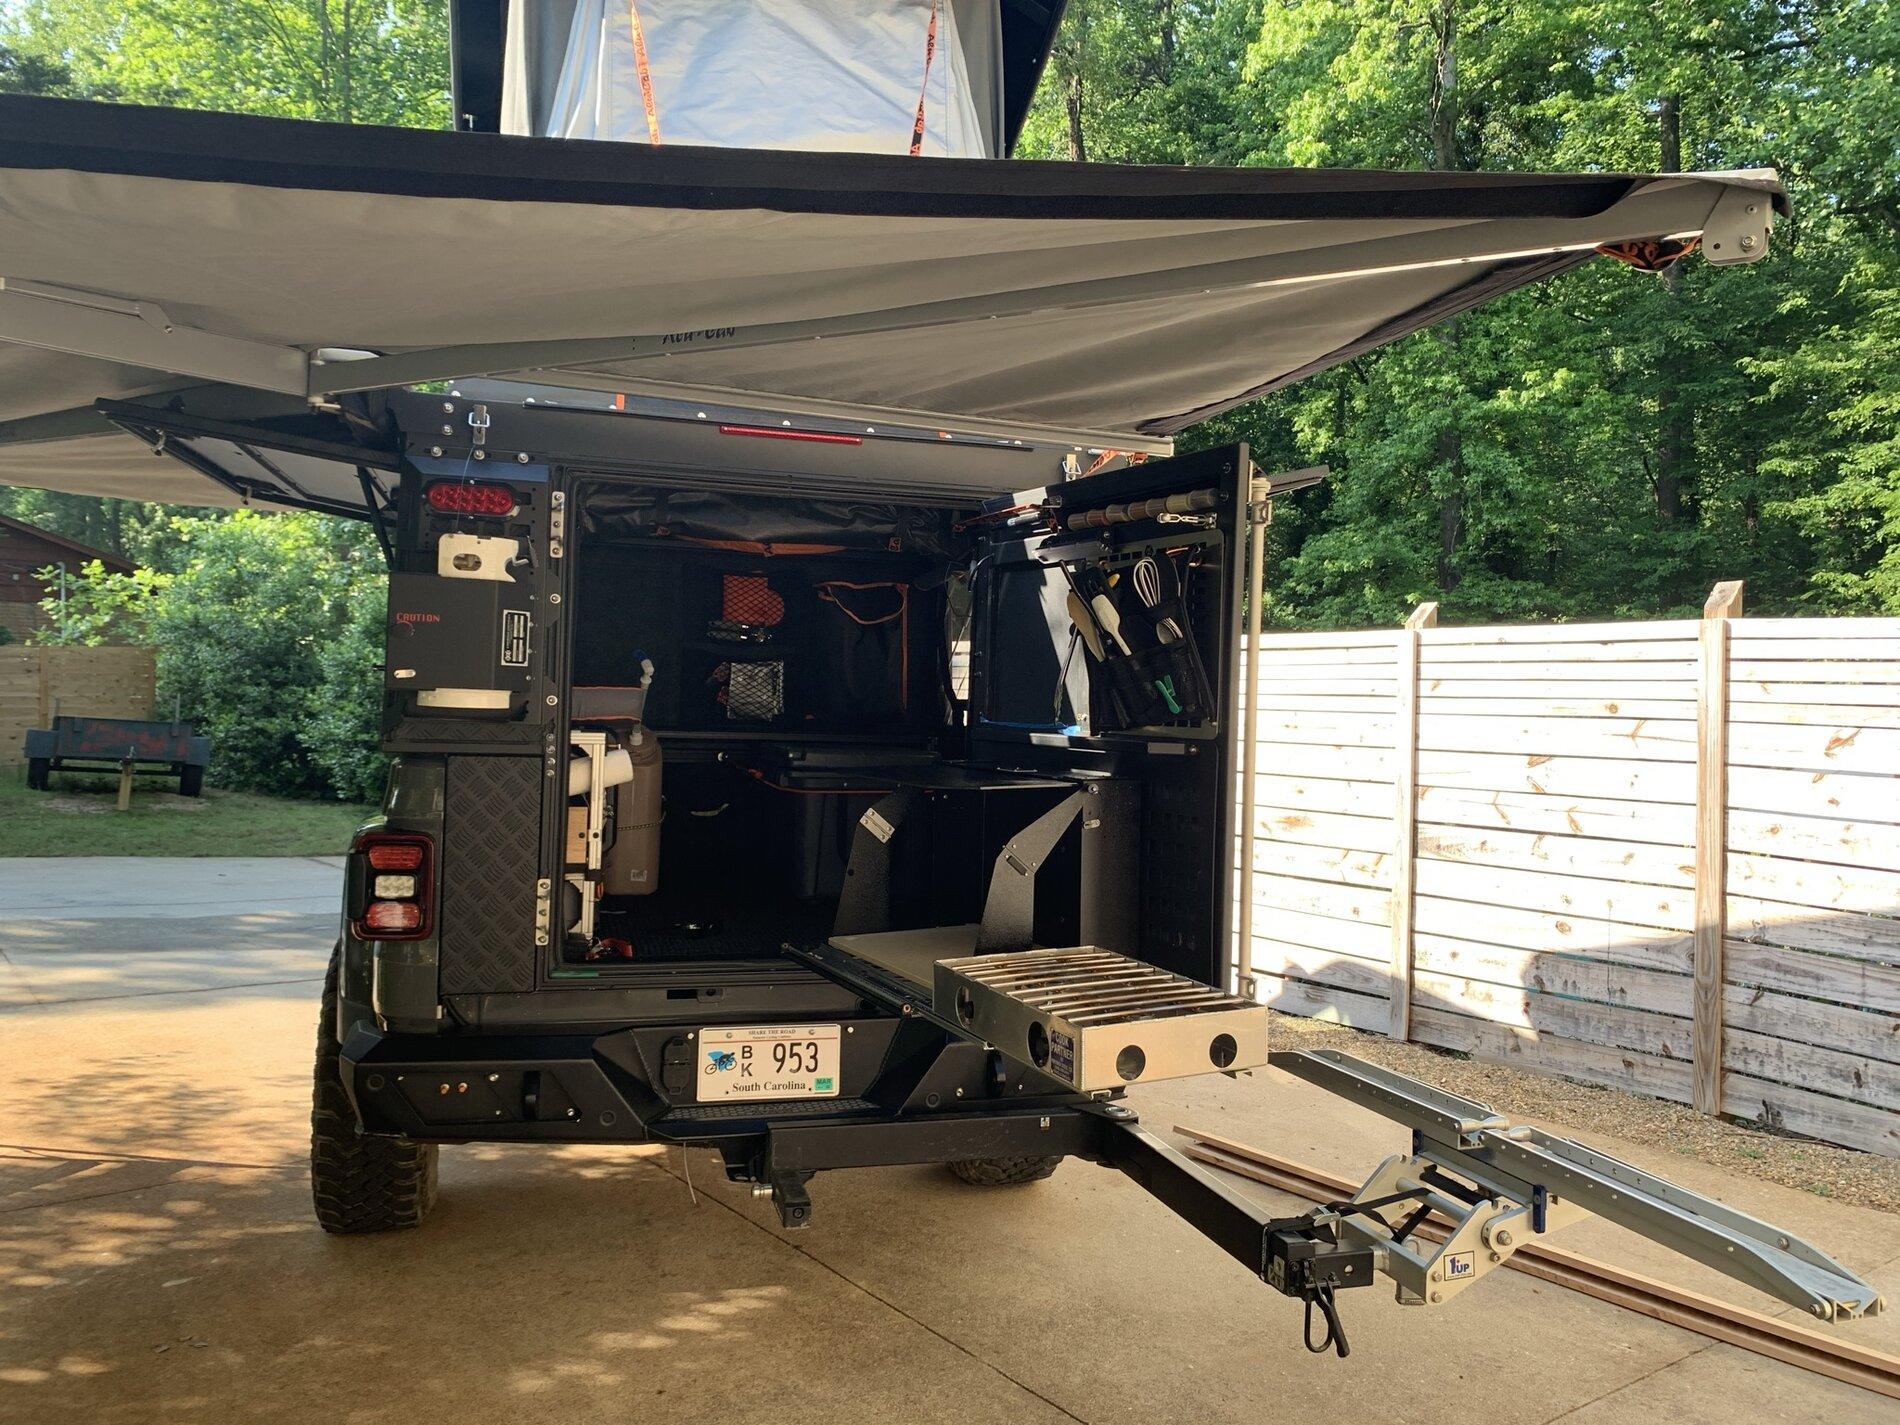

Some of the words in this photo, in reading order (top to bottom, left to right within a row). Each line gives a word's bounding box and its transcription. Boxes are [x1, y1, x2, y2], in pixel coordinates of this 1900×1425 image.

[396, 612, 441, 623] CAUTION
[773, 1042, 818, 1074] 953
[732, 1082, 761, 1092] South
[763, 1081, 806, 1091] Carolina
